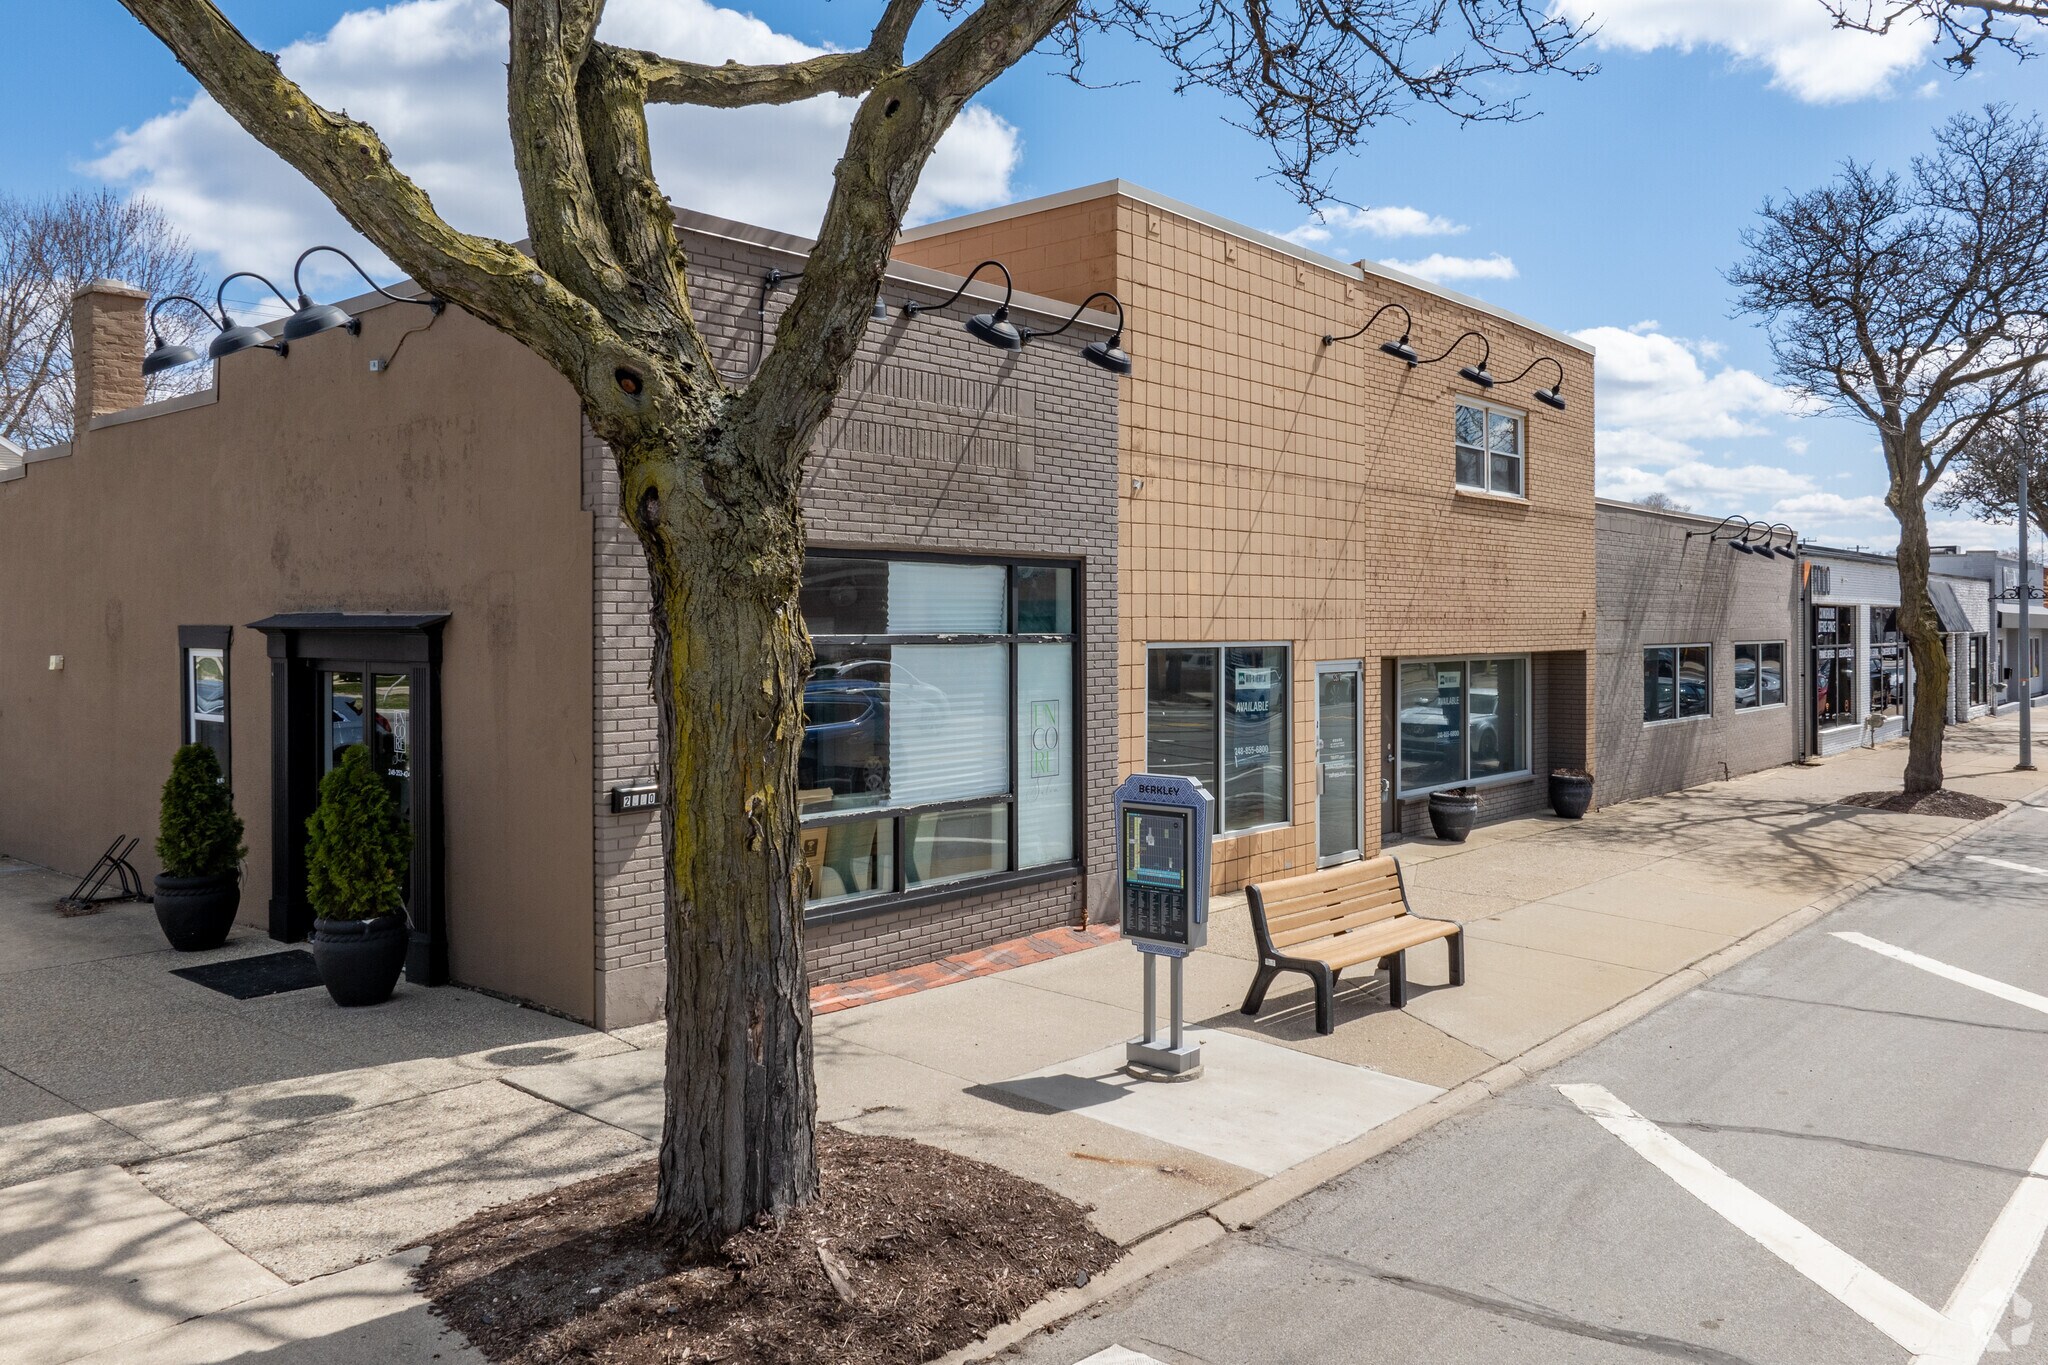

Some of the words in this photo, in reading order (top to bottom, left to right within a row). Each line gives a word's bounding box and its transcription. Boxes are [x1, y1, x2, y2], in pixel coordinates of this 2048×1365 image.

[1235, 701, 1269, 712] AVAILABLE
[1437, 697, 1460, 706] AVAILABLE
[1234, 745, 1269, 756] 248-855-6800
[1138, 784, 1180, 796] BERKLEY
